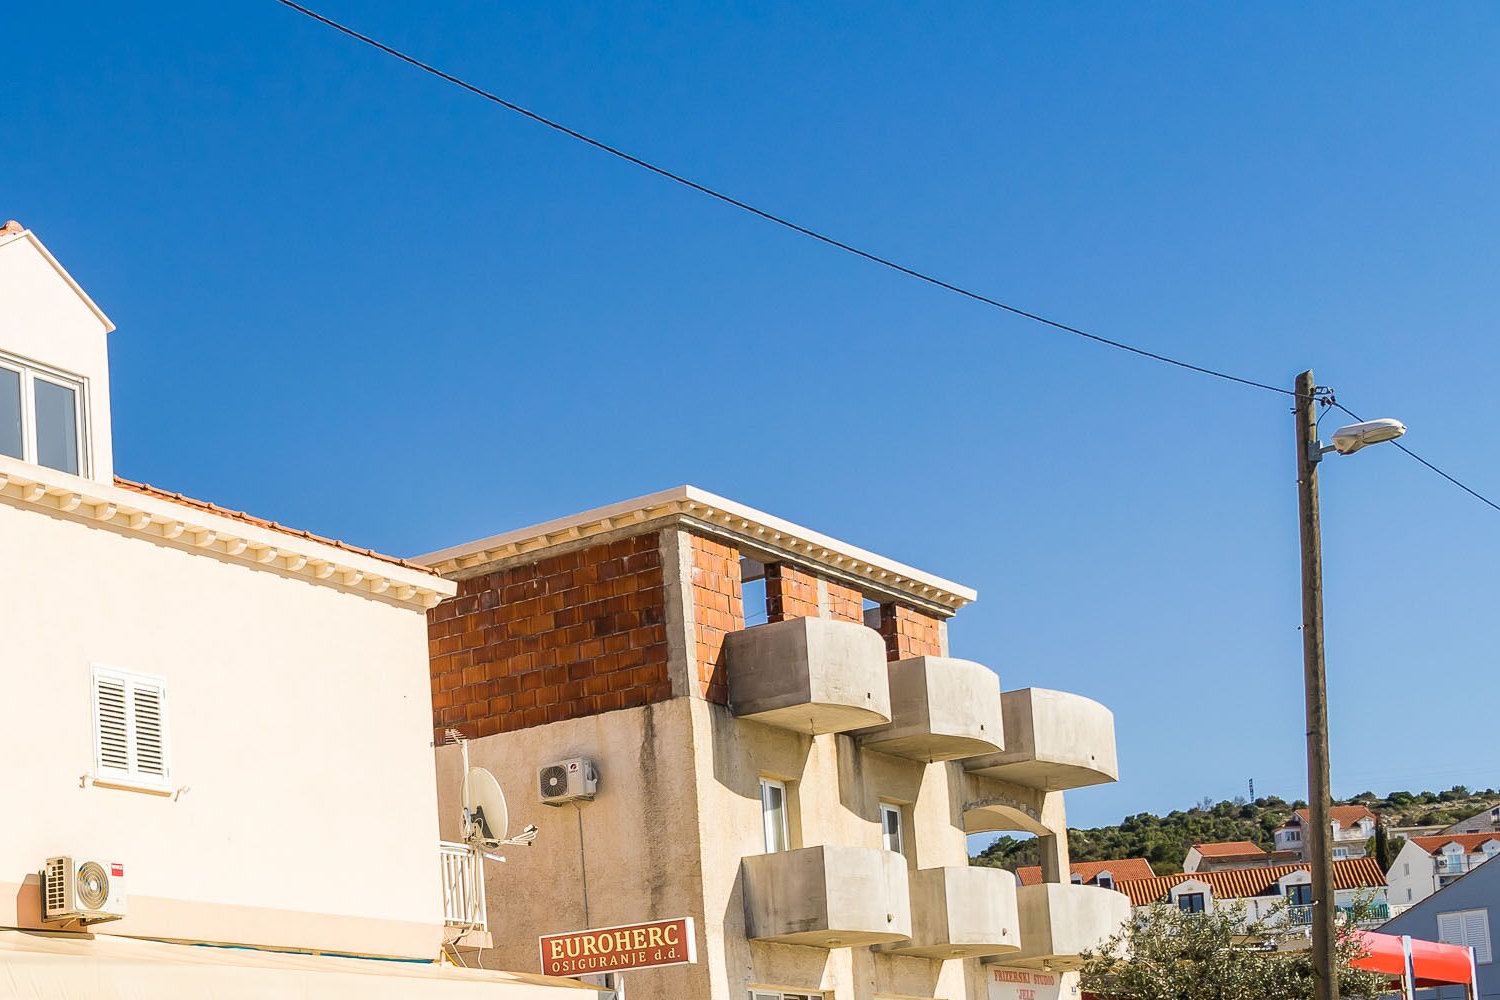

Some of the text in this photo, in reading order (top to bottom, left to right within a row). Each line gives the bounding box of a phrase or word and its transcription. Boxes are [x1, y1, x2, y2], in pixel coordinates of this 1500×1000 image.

[550, 924, 679, 960] EUROHERC
[551, 948, 682, 973] OSIGURANJE d.d.
[994, 970, 1055, 986] FRIZERSKI STUDIO
